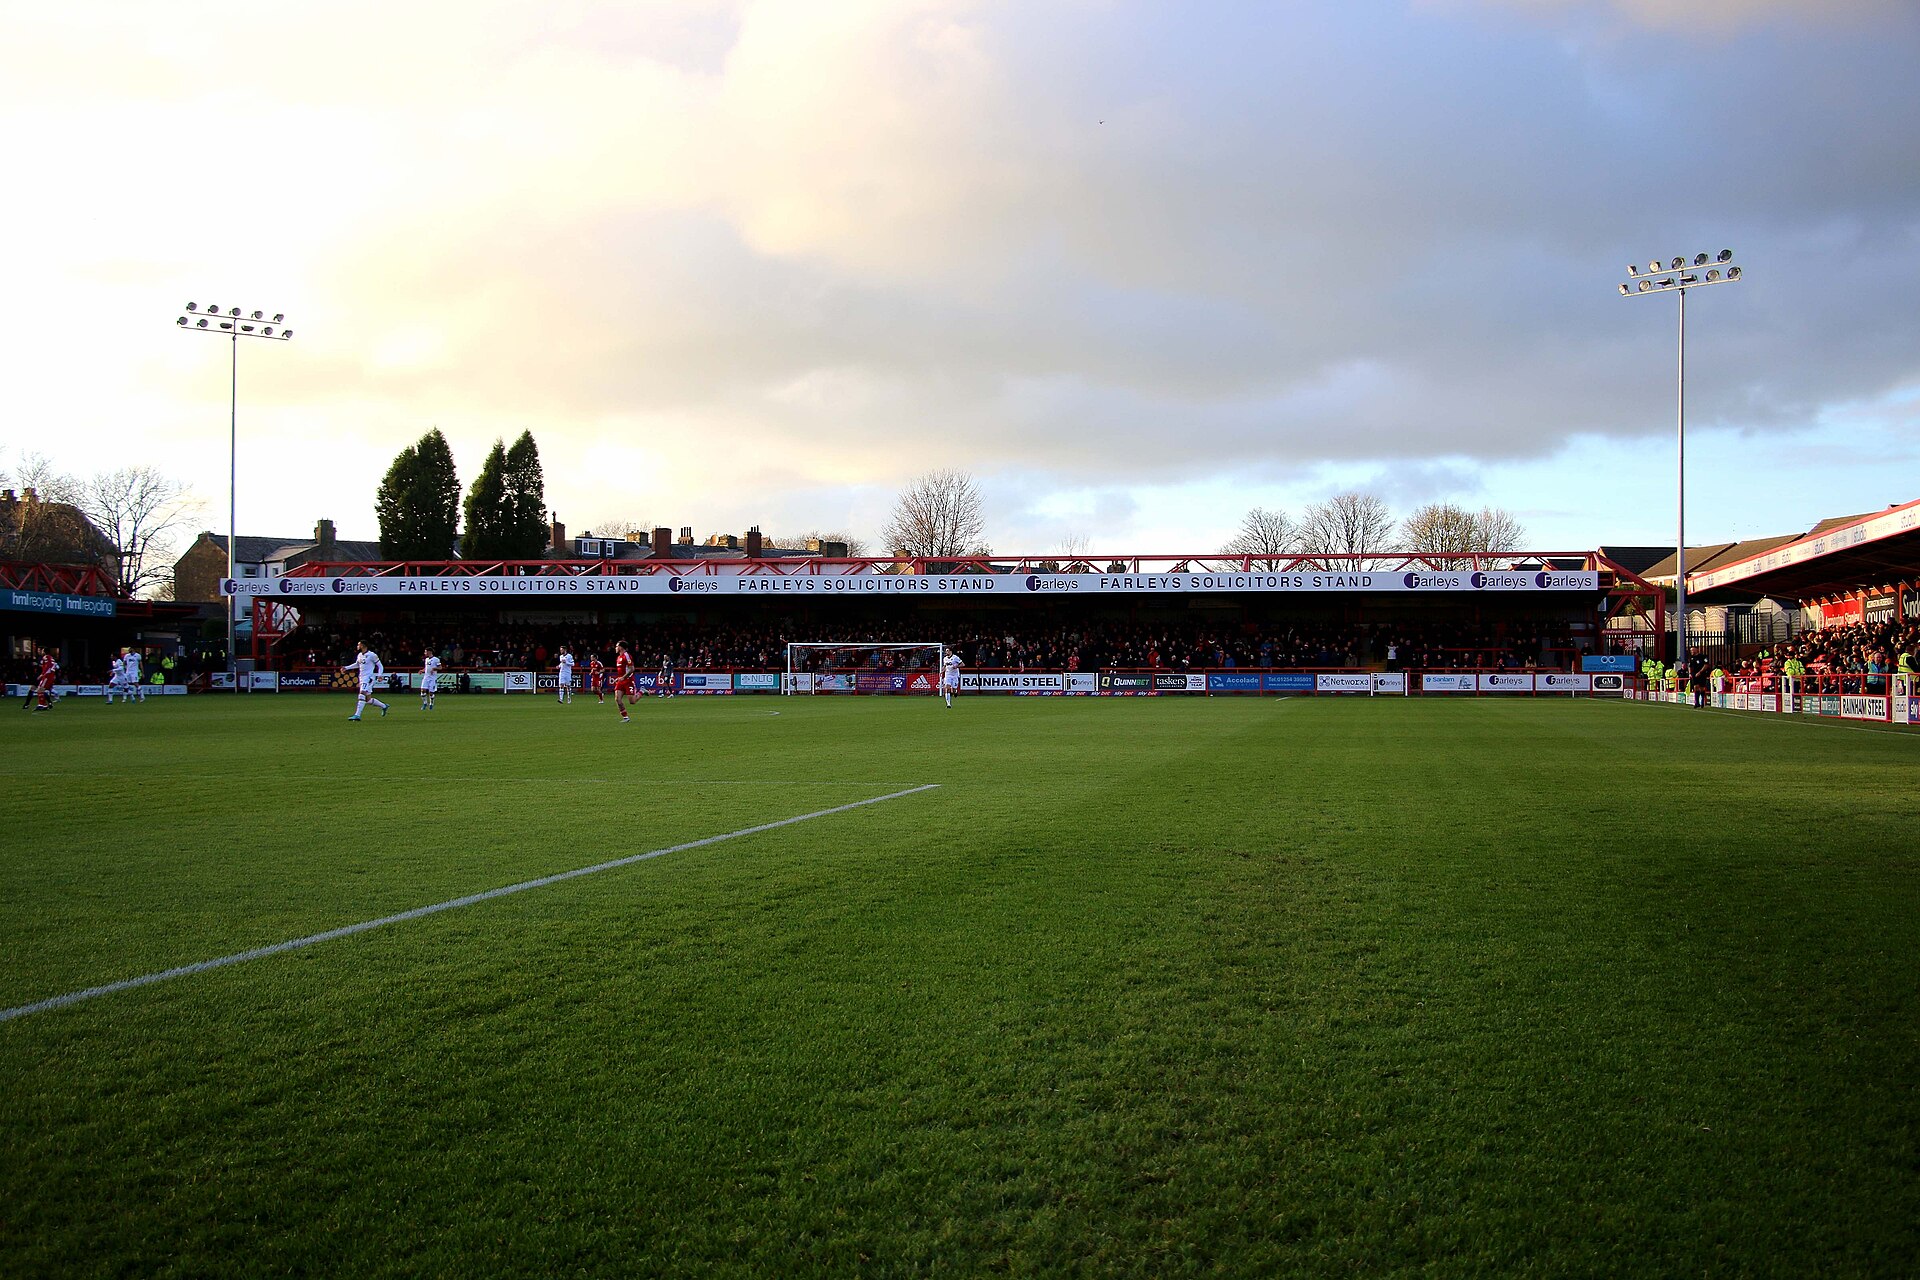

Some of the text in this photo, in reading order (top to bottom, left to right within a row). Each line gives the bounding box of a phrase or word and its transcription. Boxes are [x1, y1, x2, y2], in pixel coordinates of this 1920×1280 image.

[228, 580, 270, 594] Farleys
[283, 580, 325, 594] Farleys
[336, 579, 379, 593] Farleys
[399, 580, 639, 591] FARLEYS SOLICITORS STAND
[673, 578, 718, 592] Farleys
[738, 579, 995, 590] FARLEYS SOLICITORS STAND
[1031, 576, 1078, 592] Farleys
[1100, 576, 1372, 588] FARLEYS SOLICITORS STAND
[1409, 574, 1459, 590] Farleys
[1476, 573, 1527, 589] Farleys
[1540, 573, 1592, 589] Farleys
[280, 677, 316, 686] Sundown
[538, 679, 582, 688] COLGE
[639, 676, 676, 686] sky bt
[962, 678, 1061, 687] RAINHAM STEEL
[1156, 676, 1186, 685] taskers
[1493, 676, 1523, 685] Farleys
[1549, 676, 1580, 685] Farleys
[1842, 697, 1885, 717] RAINHAM STEEL
